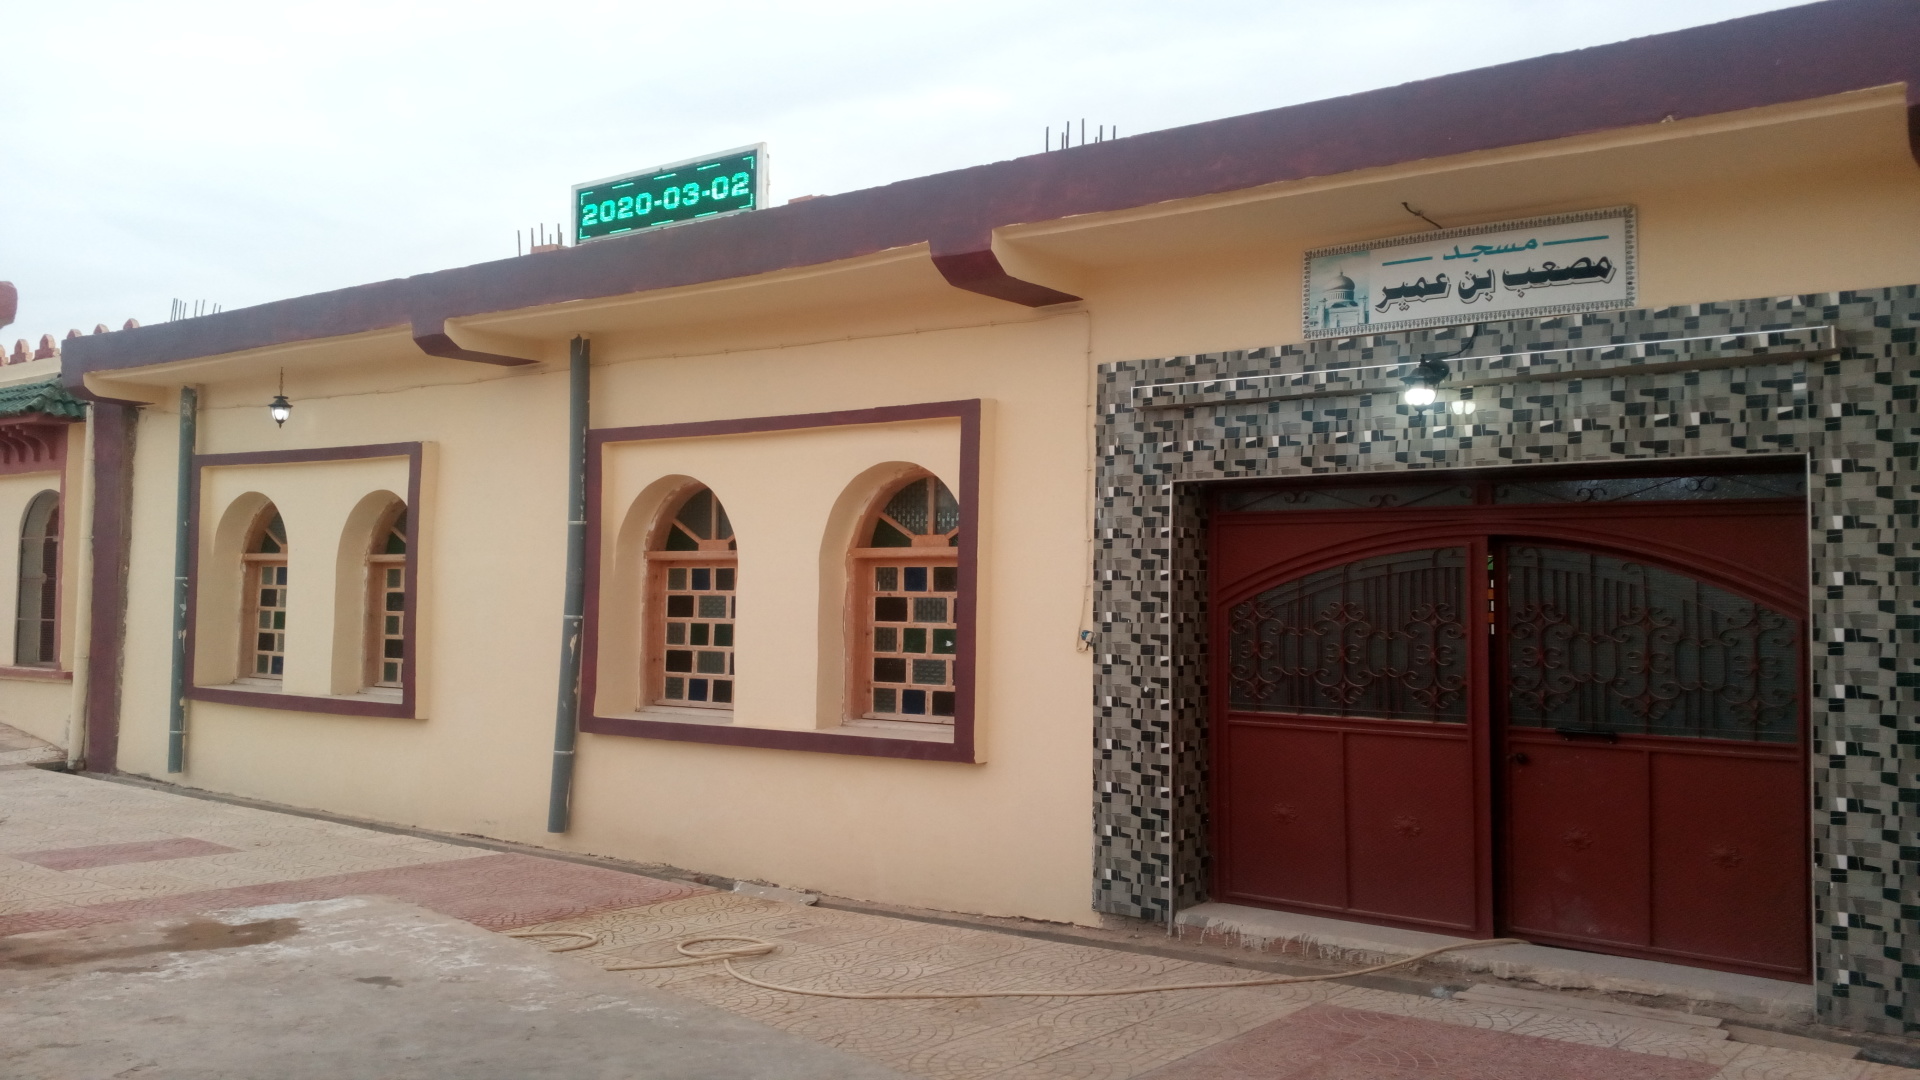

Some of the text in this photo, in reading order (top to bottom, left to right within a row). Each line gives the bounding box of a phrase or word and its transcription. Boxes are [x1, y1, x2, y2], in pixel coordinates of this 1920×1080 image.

[582, 172, 750, 226] 2020-03-02
[1443, 238, 1539, 262] مسجد
[1375, 256, 1616, 313] مصعب بن عمير
